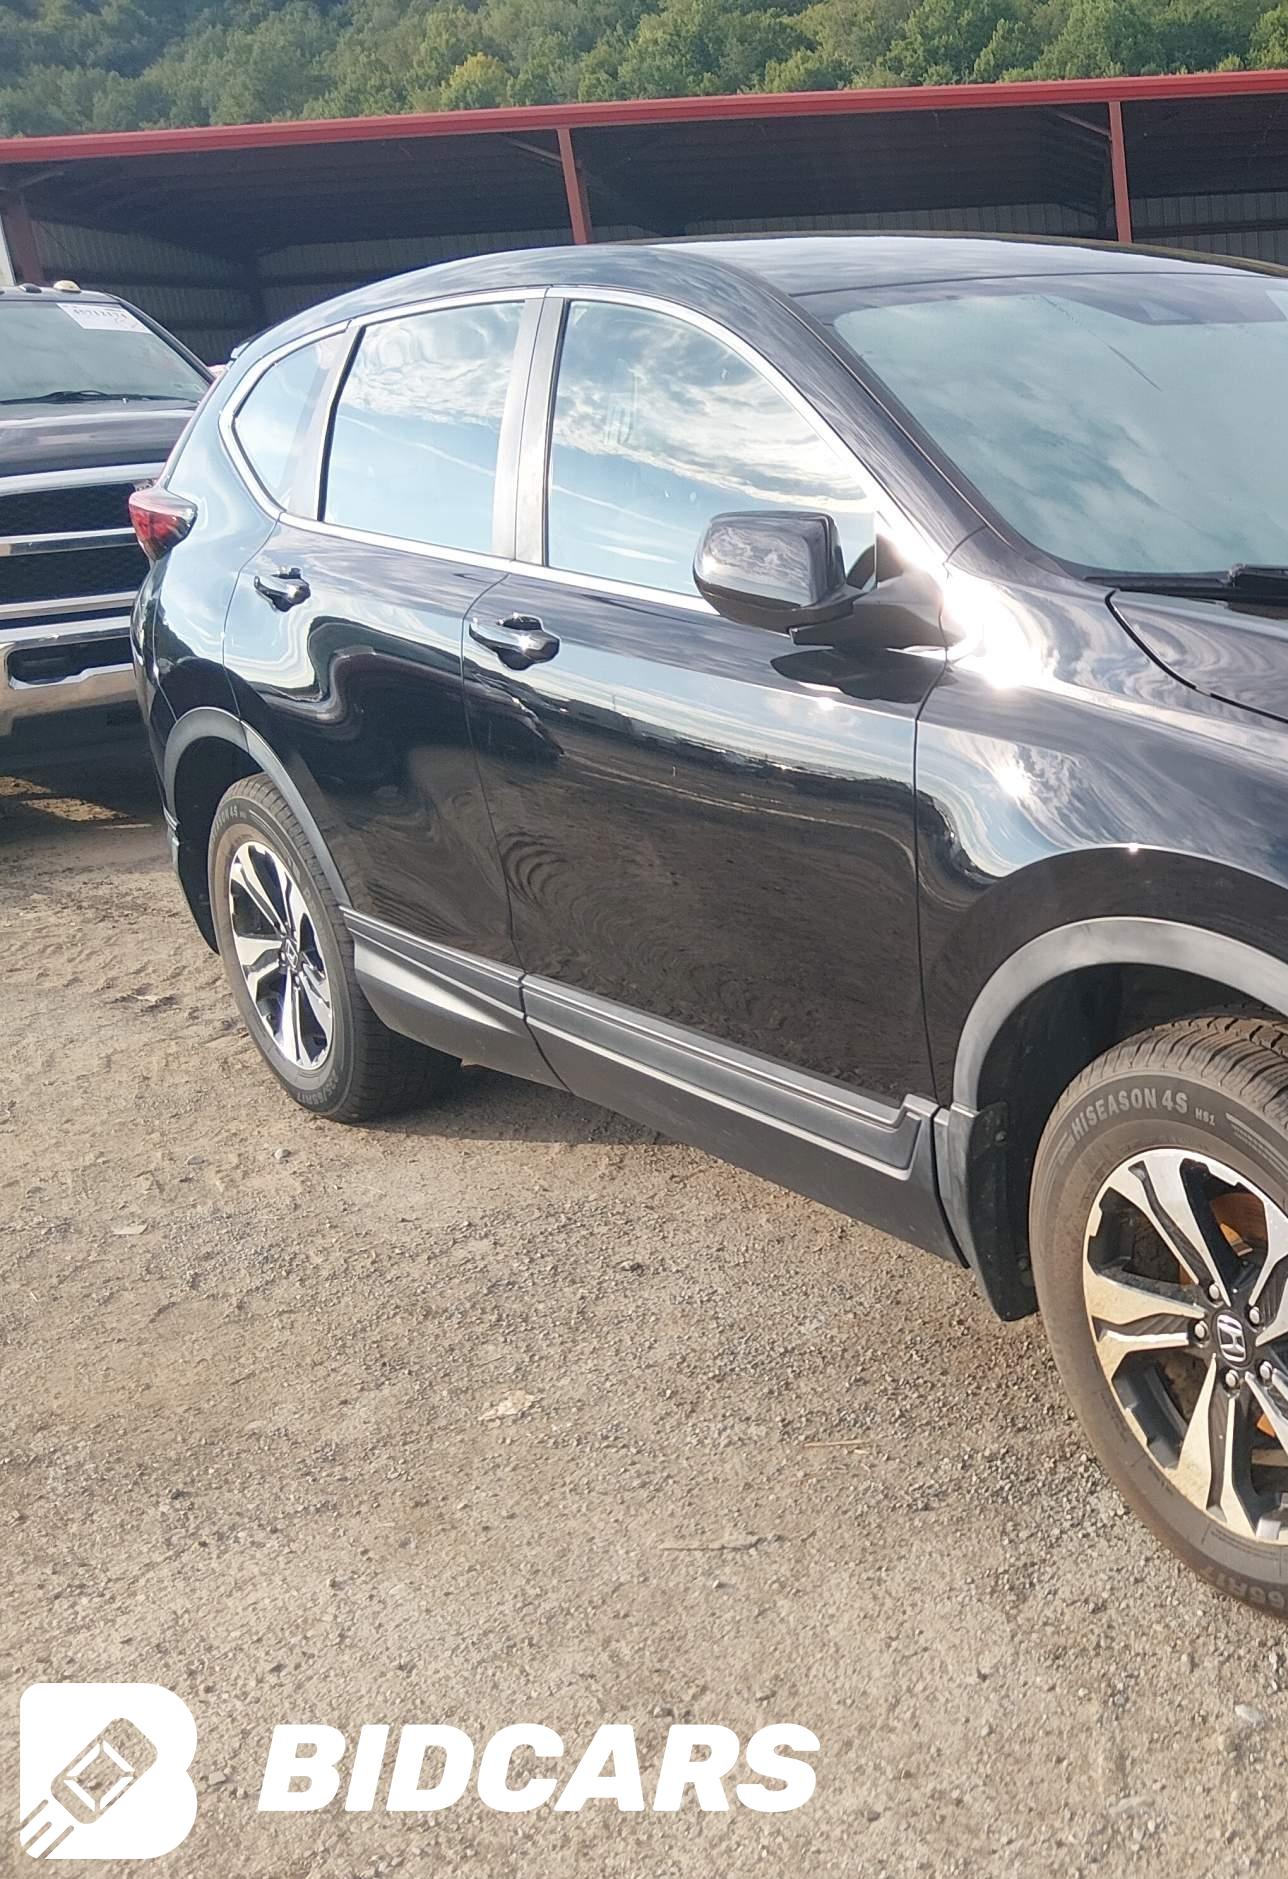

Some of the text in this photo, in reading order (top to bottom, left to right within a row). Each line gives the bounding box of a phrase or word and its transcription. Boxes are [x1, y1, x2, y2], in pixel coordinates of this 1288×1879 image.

[1071, 1088, 1216, 1142] HISEASON 4S HS1
